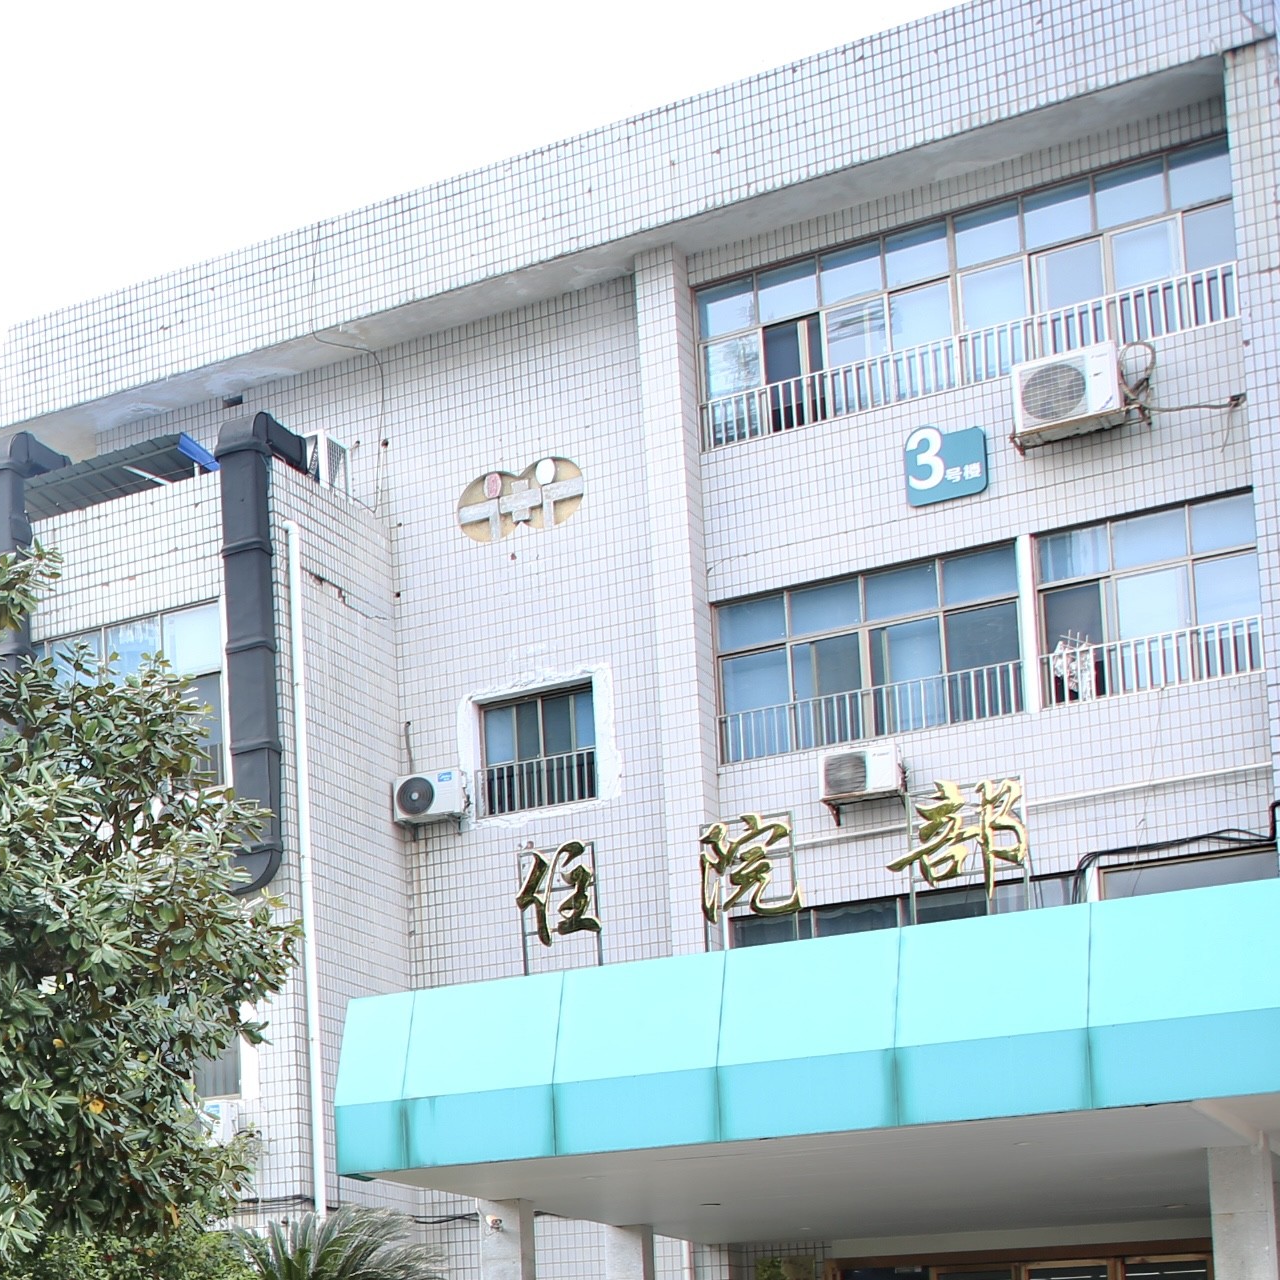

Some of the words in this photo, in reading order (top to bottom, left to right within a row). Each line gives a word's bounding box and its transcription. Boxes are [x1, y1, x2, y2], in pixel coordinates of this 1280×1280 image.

[906, 428, 982, 490] 3号楼
[516, 779, 1027, 947] 住院部
